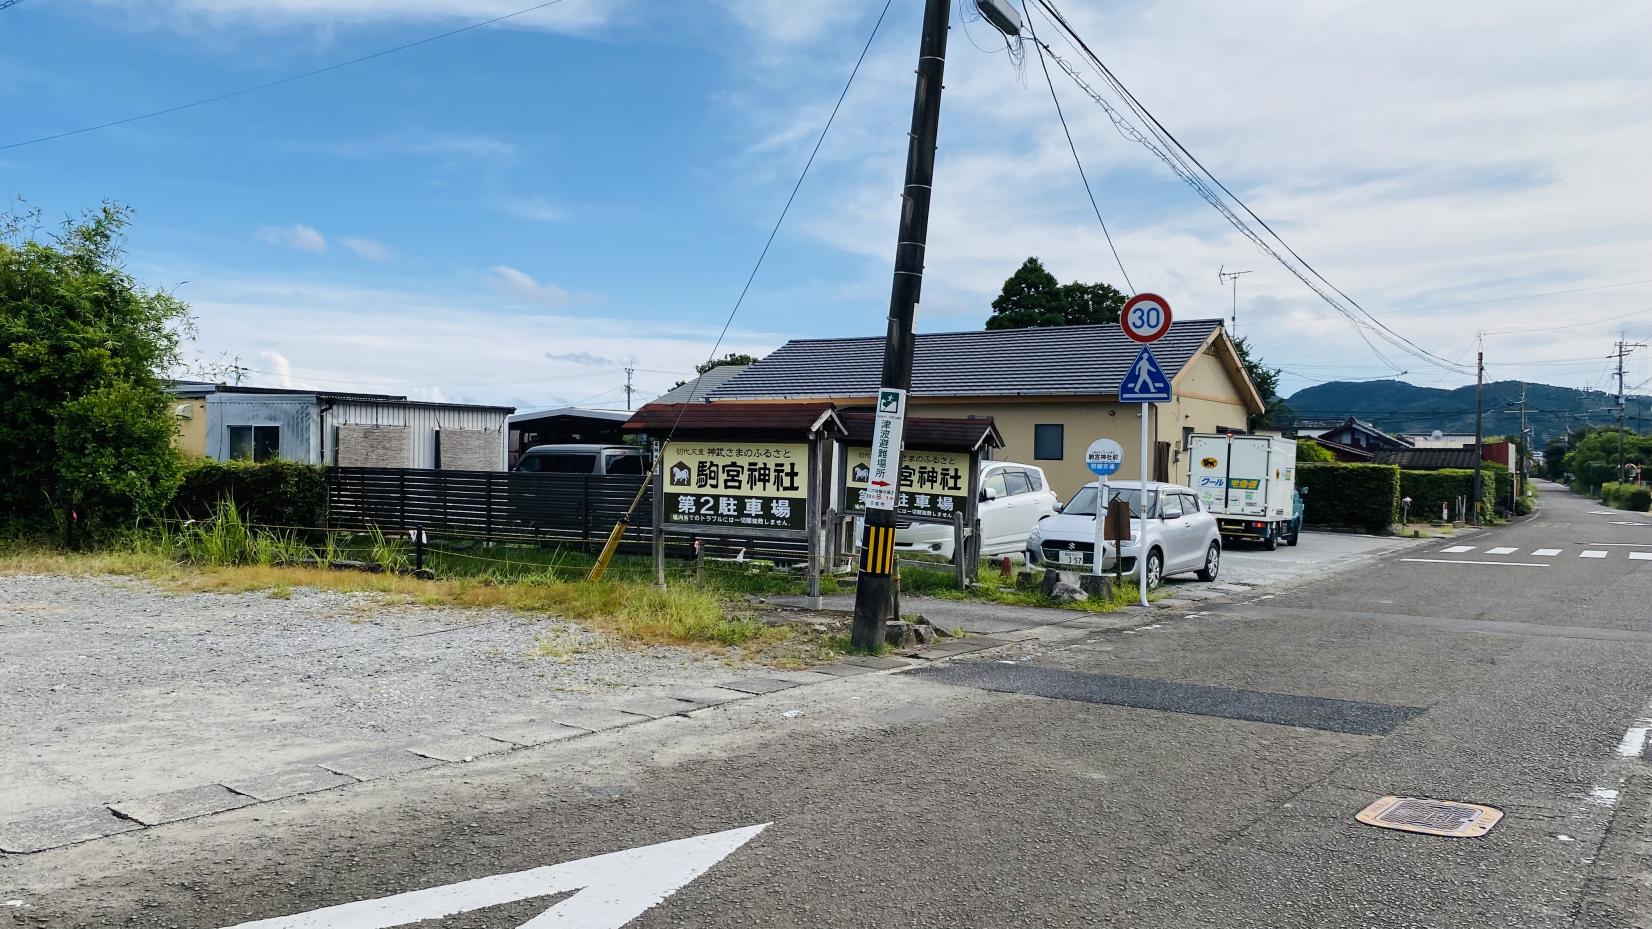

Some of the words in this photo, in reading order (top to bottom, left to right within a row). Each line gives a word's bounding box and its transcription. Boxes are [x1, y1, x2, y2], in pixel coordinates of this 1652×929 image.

[1132, 307, 1160, 329] 30
[875, 419, 891, 478] 津波避難場所
[696, 460, 800, 492] 駒宮神社
[900, 465, 962, 491] 宮神社
[1201, 478, 1224, 487] クール
[678, 495, 791, 519] 第2駐車場
